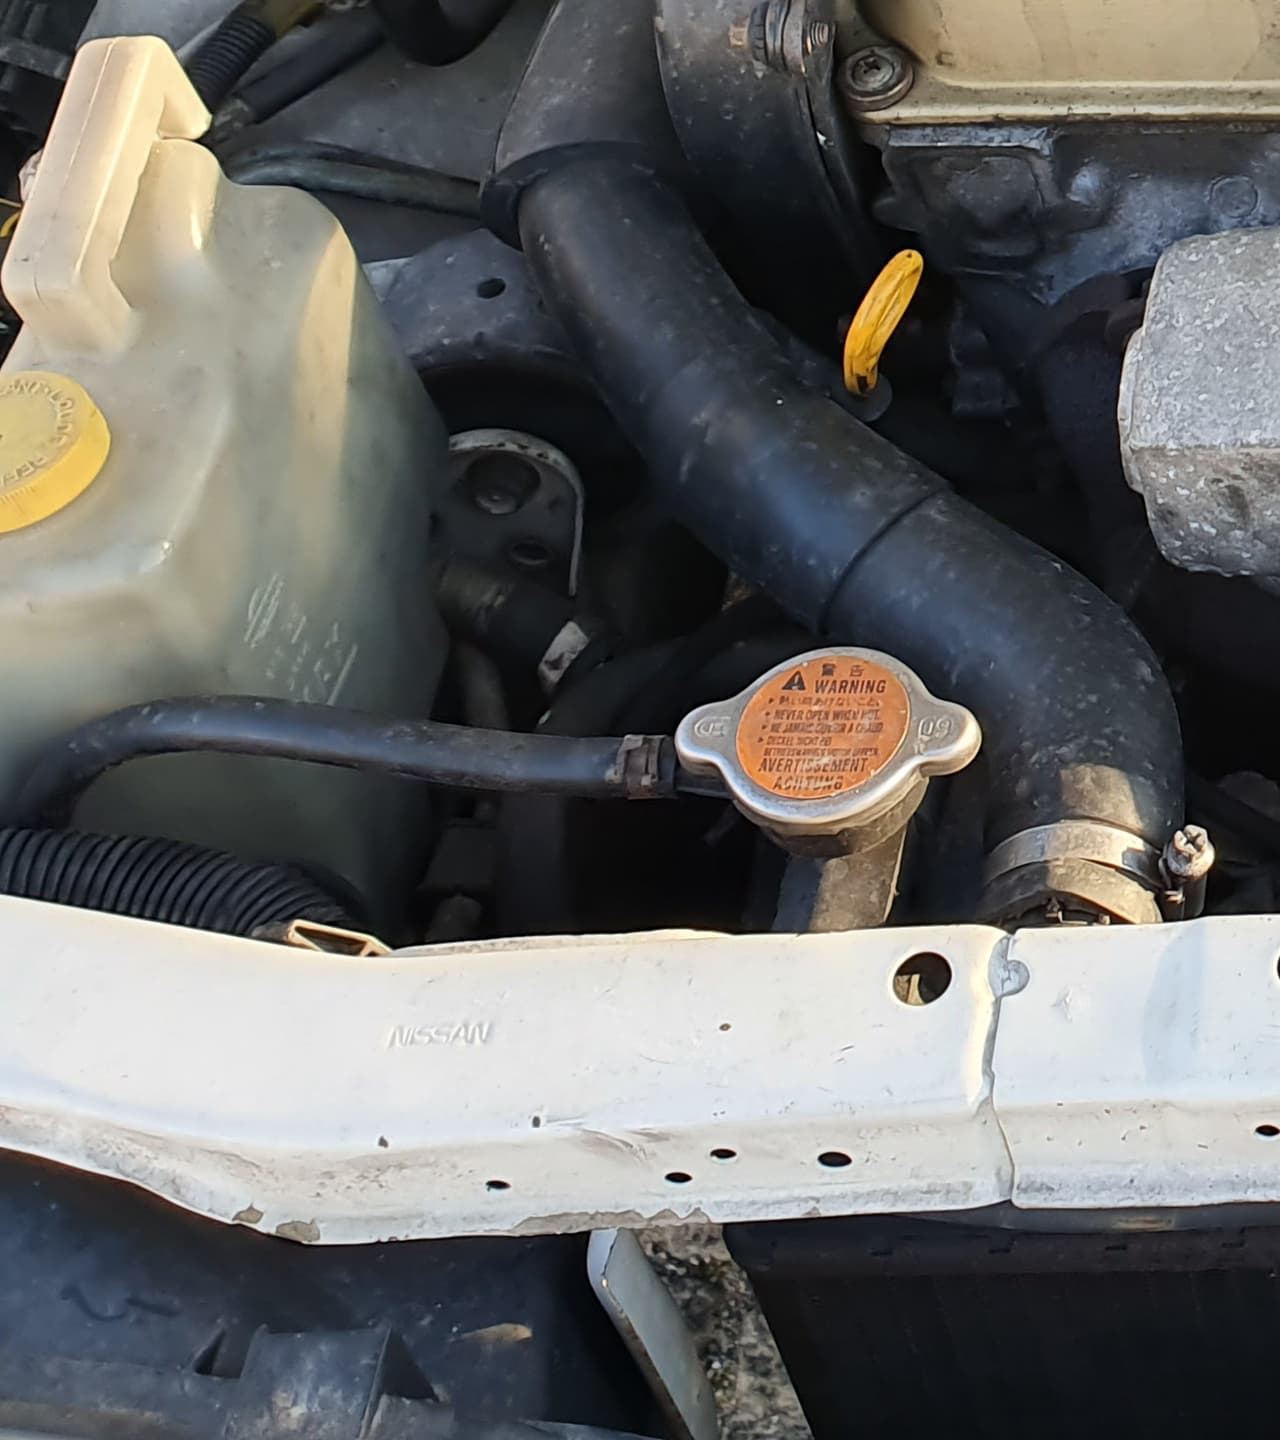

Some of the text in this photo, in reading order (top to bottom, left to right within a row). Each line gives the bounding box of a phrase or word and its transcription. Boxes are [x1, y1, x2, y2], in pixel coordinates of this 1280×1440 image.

[815, 679, 887, 694] WARNING
[774, 709, 803, 721] NEVER
[805, 709, 829, 721] OPEN
[758, 757, 869, 773] AVERTISSEMENT
[772, 775, 844, 791] ACHTUNG
[387, 1021, 492, 1049] NISSAN
